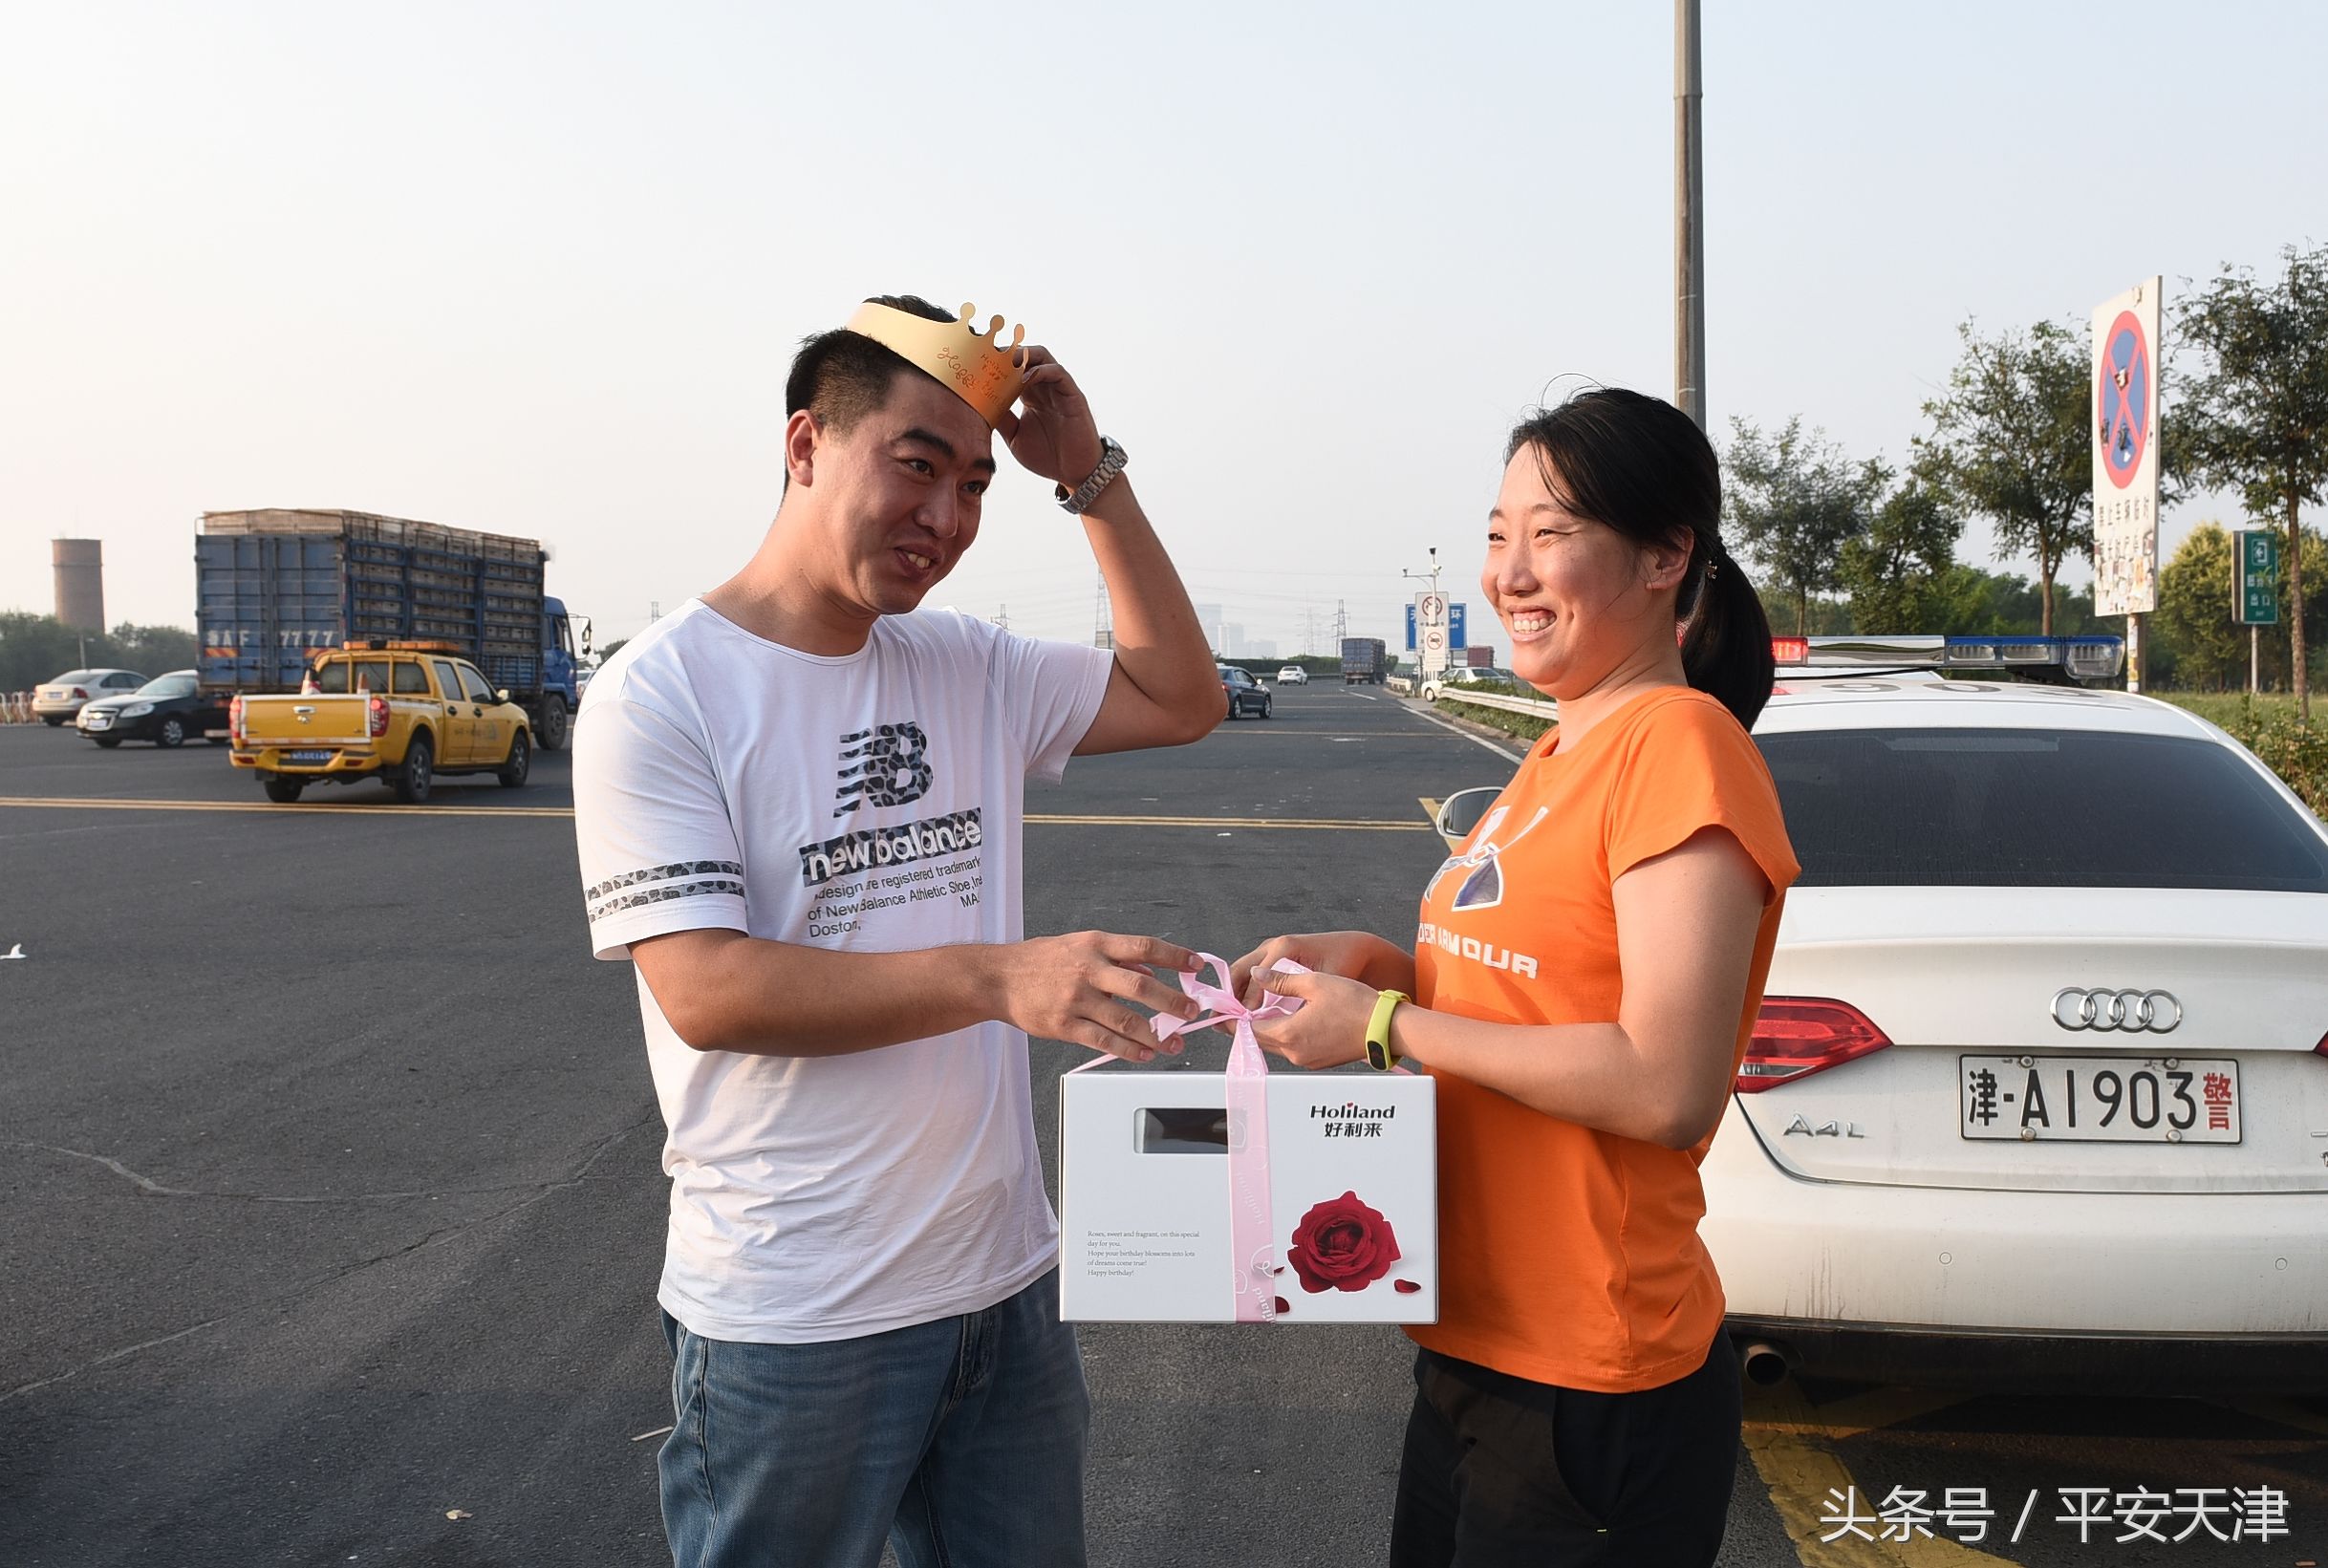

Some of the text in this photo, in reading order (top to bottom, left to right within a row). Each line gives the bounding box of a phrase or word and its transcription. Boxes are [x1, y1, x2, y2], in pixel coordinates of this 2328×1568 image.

[281, 630, 334, 649] 7777
[808, 819, 981, 881] new balance
[808, 907, 822, 921] of
[909, 885, 947, 902] Athletic
[1437, 927, 1539, 979] ARMOUR
[1310, 1102, 1396, 1120] Holiland
[1324, 1122, 1383, 1138] 好利来
[1783, 1113, 1865, 1139] A4L
[1180, 1231, 1200, 1239] special
[1088, 1269, 1108, 1278] Happy
